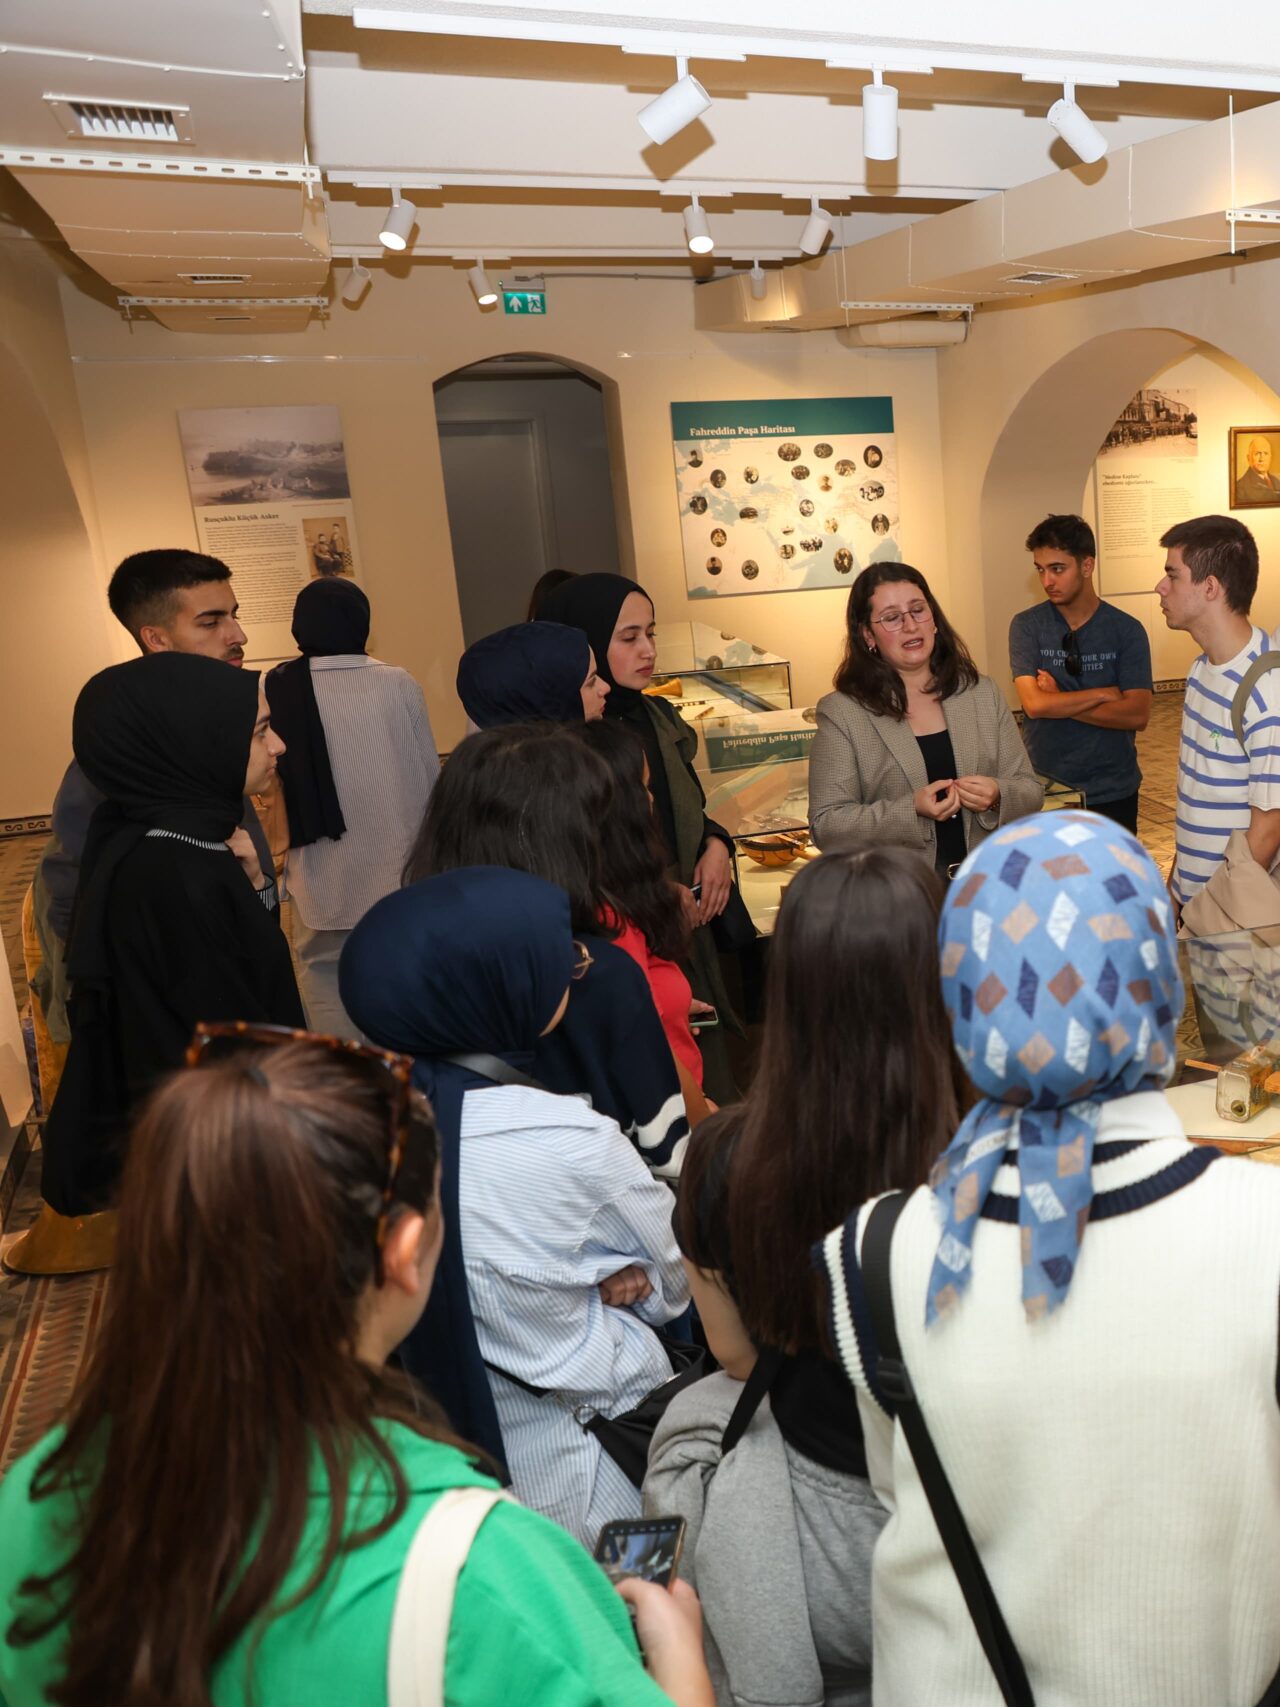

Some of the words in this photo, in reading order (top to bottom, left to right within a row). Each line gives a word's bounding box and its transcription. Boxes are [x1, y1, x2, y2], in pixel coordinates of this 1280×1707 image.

[690, 426, 736, 437] Fahreddin
[738, 426, 759, 437] Paşa
[760, 424, 796, 434] Haritası
[1040, 649, 1055, 657] YOU
[1100, 651, 1117, 660] OWN
